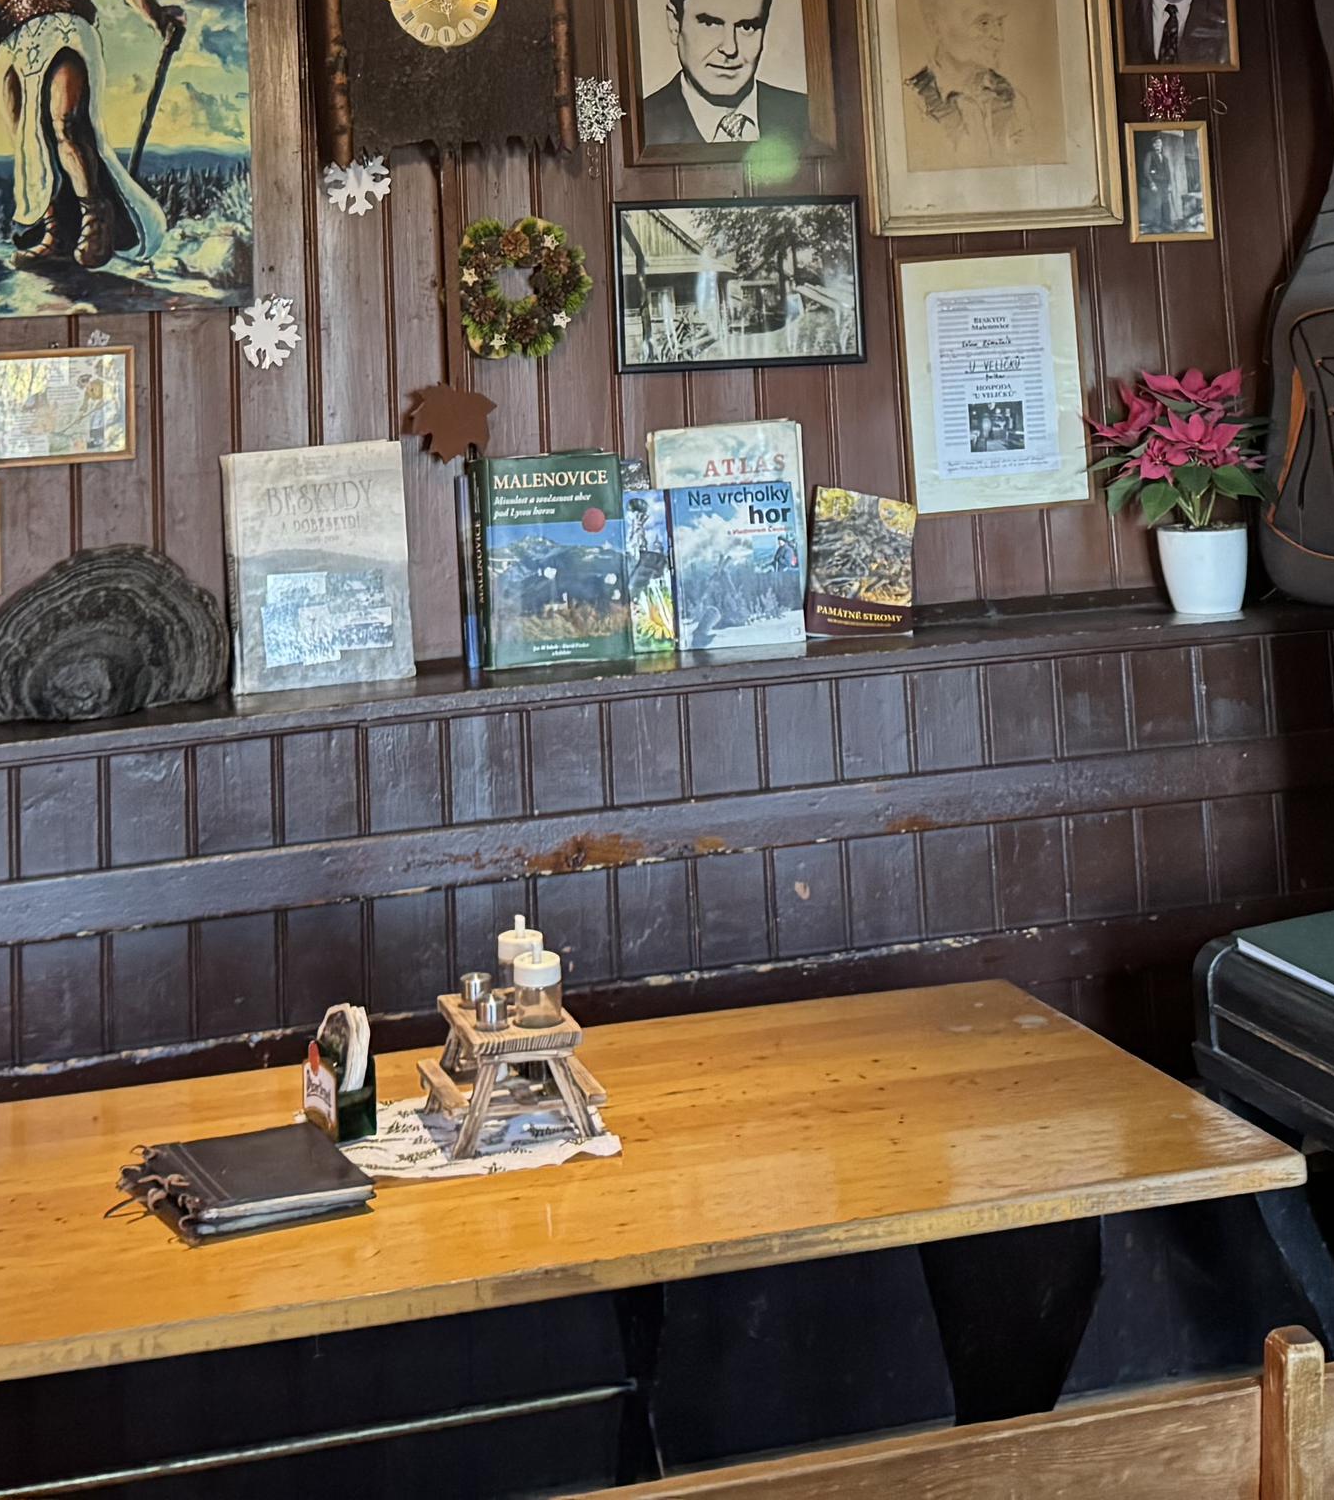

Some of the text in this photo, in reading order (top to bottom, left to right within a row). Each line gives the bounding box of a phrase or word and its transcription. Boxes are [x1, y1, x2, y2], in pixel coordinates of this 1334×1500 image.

[975, 382, 1012, 392] HOSPODA
[703, 453, 786, 478] ATLAS
[493, 470, 609, 490] MALENOVICE
[266, 479, 374, 517] BESKYDY
[687, 485, 790, 507] Na vrcholky
[748, 505, 791, 525] hor
[475, 520, 487, 605] MALENOVICE
[816, 604, 862, 621] PAMÁTNÉ
[861, 612, 904, 624] STROMY
